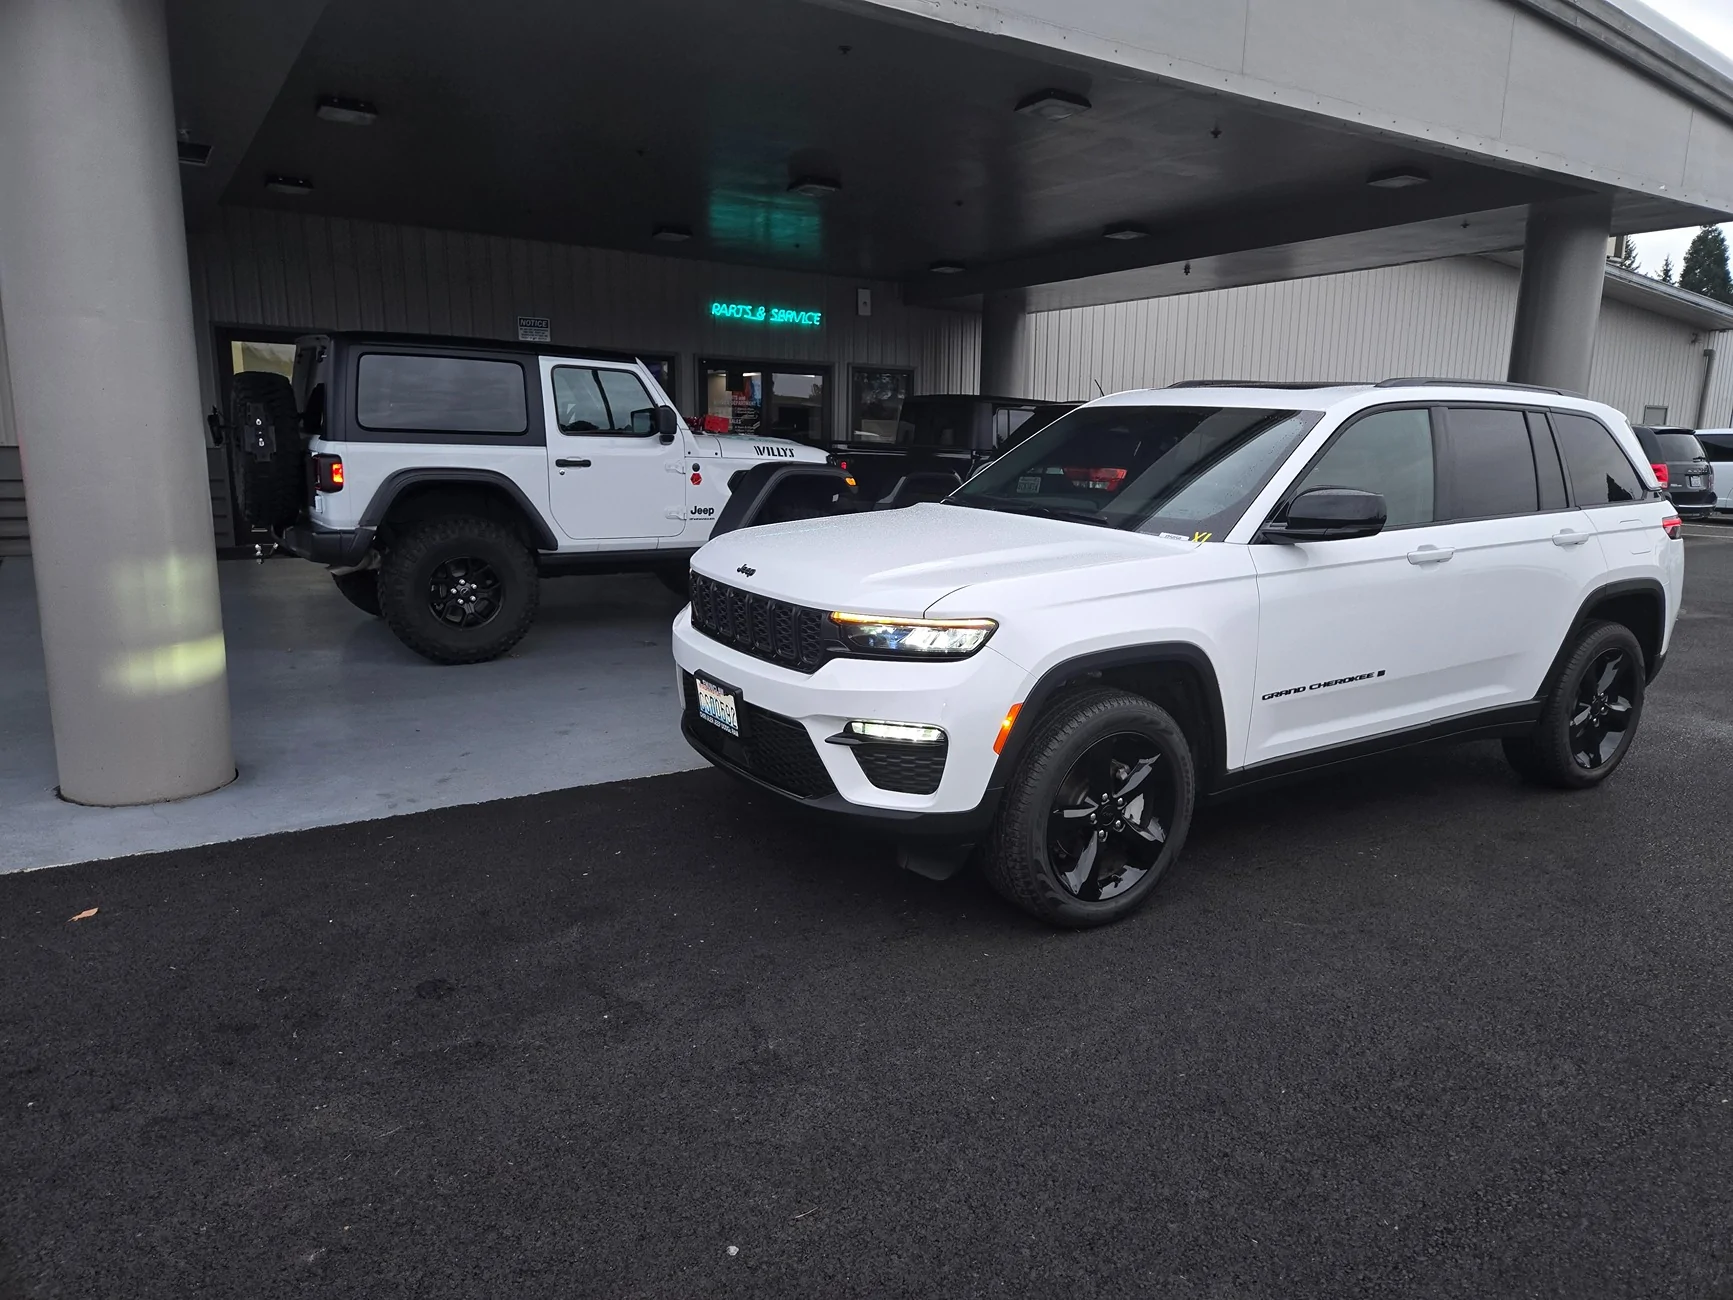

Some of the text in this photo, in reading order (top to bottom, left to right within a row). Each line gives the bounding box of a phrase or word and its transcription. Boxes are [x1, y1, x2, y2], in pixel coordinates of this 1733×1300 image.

[711, 302, 822, 326] PARTS & SERVICE
[520, 319, 548, 328] NOTICE
[753, 445, 795, 458] WILLYS
[690, 505, 715, 517] Jeep
[736, 563, 757, 578] Jeep
[1261, 671, 1375, 701] GRAND CHEROKEE
